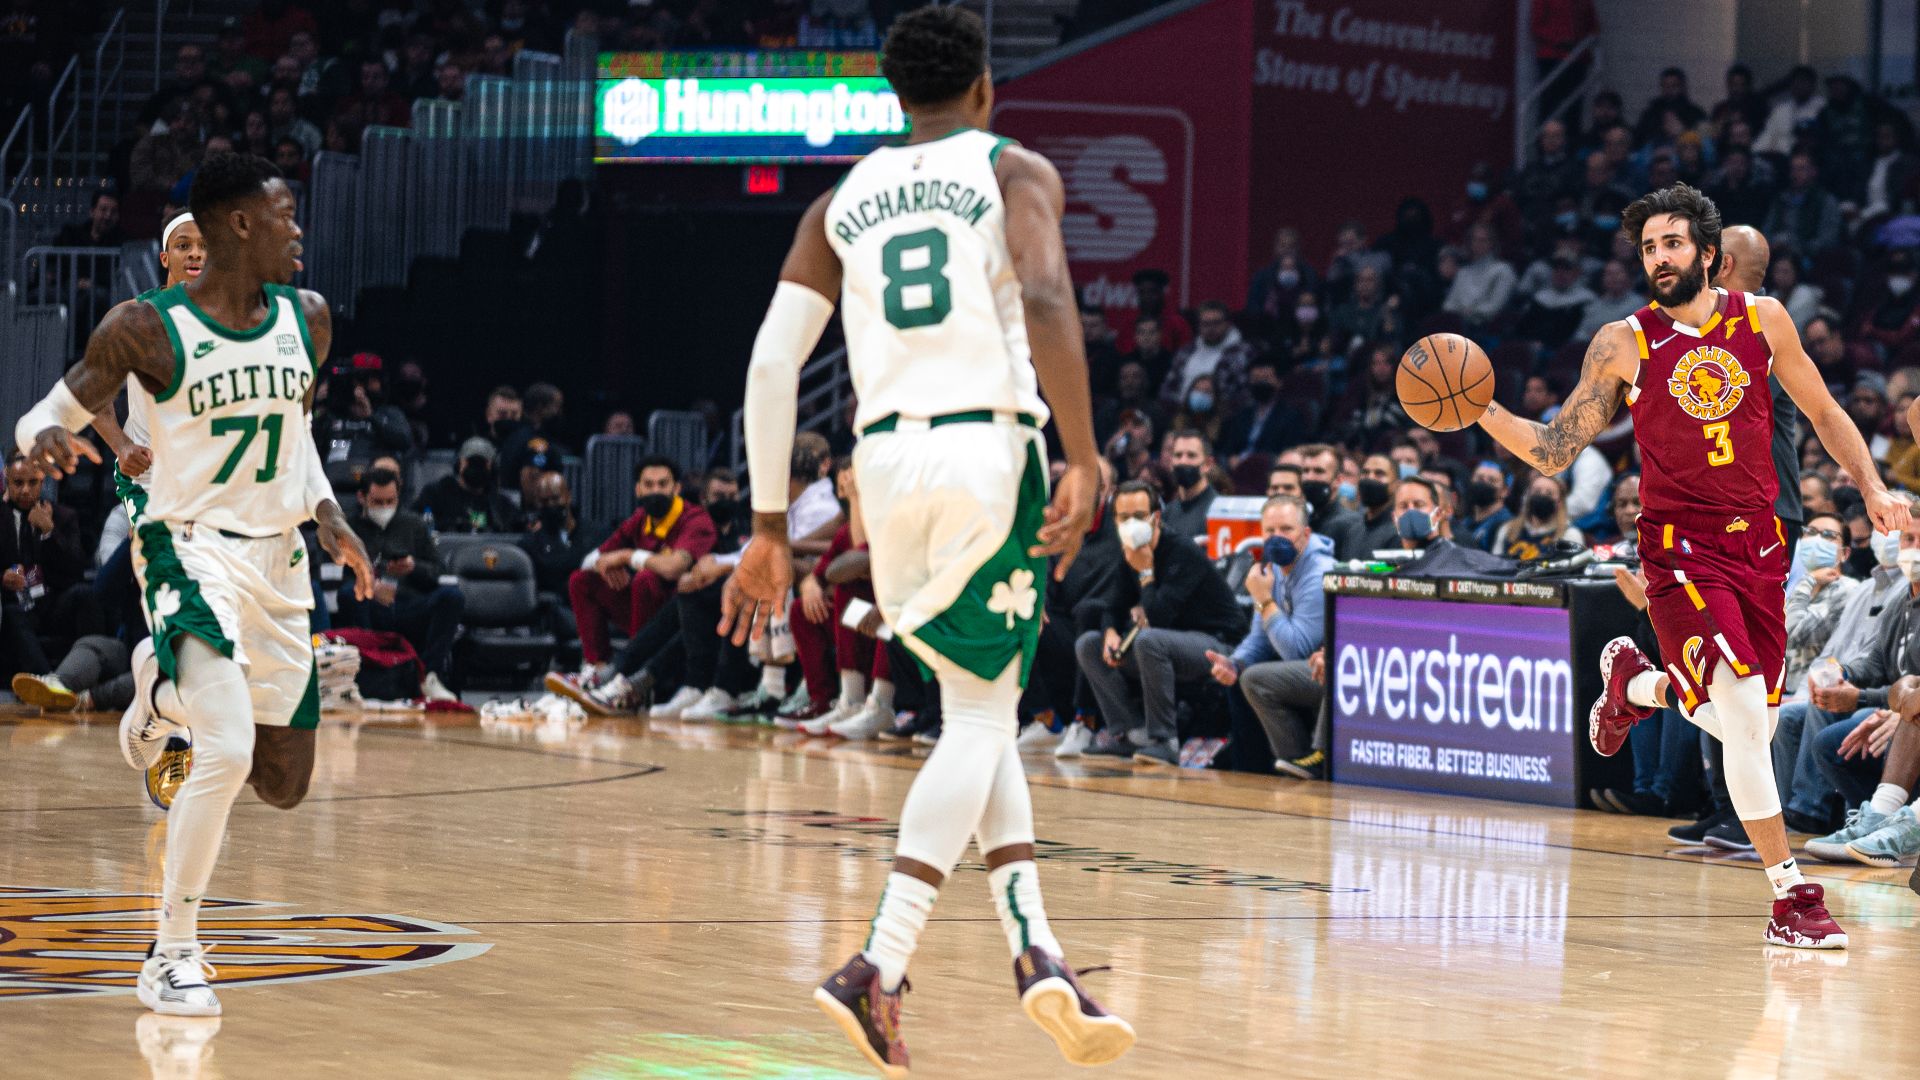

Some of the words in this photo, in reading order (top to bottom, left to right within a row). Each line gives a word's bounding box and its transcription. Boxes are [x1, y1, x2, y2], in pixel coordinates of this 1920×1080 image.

[1274, 0, 1323, 38] The
[1331, 8, 1494, 59] Convenience
[1254, 49, 1339, 92] Stores
[1346, 61, 1380, 107] of
[1384, 65, 1507, 119] Speedway
[663, 77, 905, 146] Huntington
[835, 180, 992, 245] RICHARDSON
[882, 227, 952, 330] 8
[188, 364, 309, 417] CELTICS
[1668, 346, 1751, 397] CAVALIERS
[1678, 388, 1744, 420] CLEVELAND
[210, 413, 284, 484] 71
[1703, 421, 1735, 467] 3
[1411, 580, 1436, 595] Mortgage
[1448, 580, 1472, 594] ROCKET
[1472, 581, 1498, 597] Mortgage
[1503, 582, 1528, 595] ROCKET
[1528, 584, 1554, 598] Mortgage
[1337, 633, 1573, 733] everstream
[1351, 738, 1395, 766] FASTER
[1397, 743, 1434, 770] FIBER.
[1437, 747, 1484, 776] BETTER
